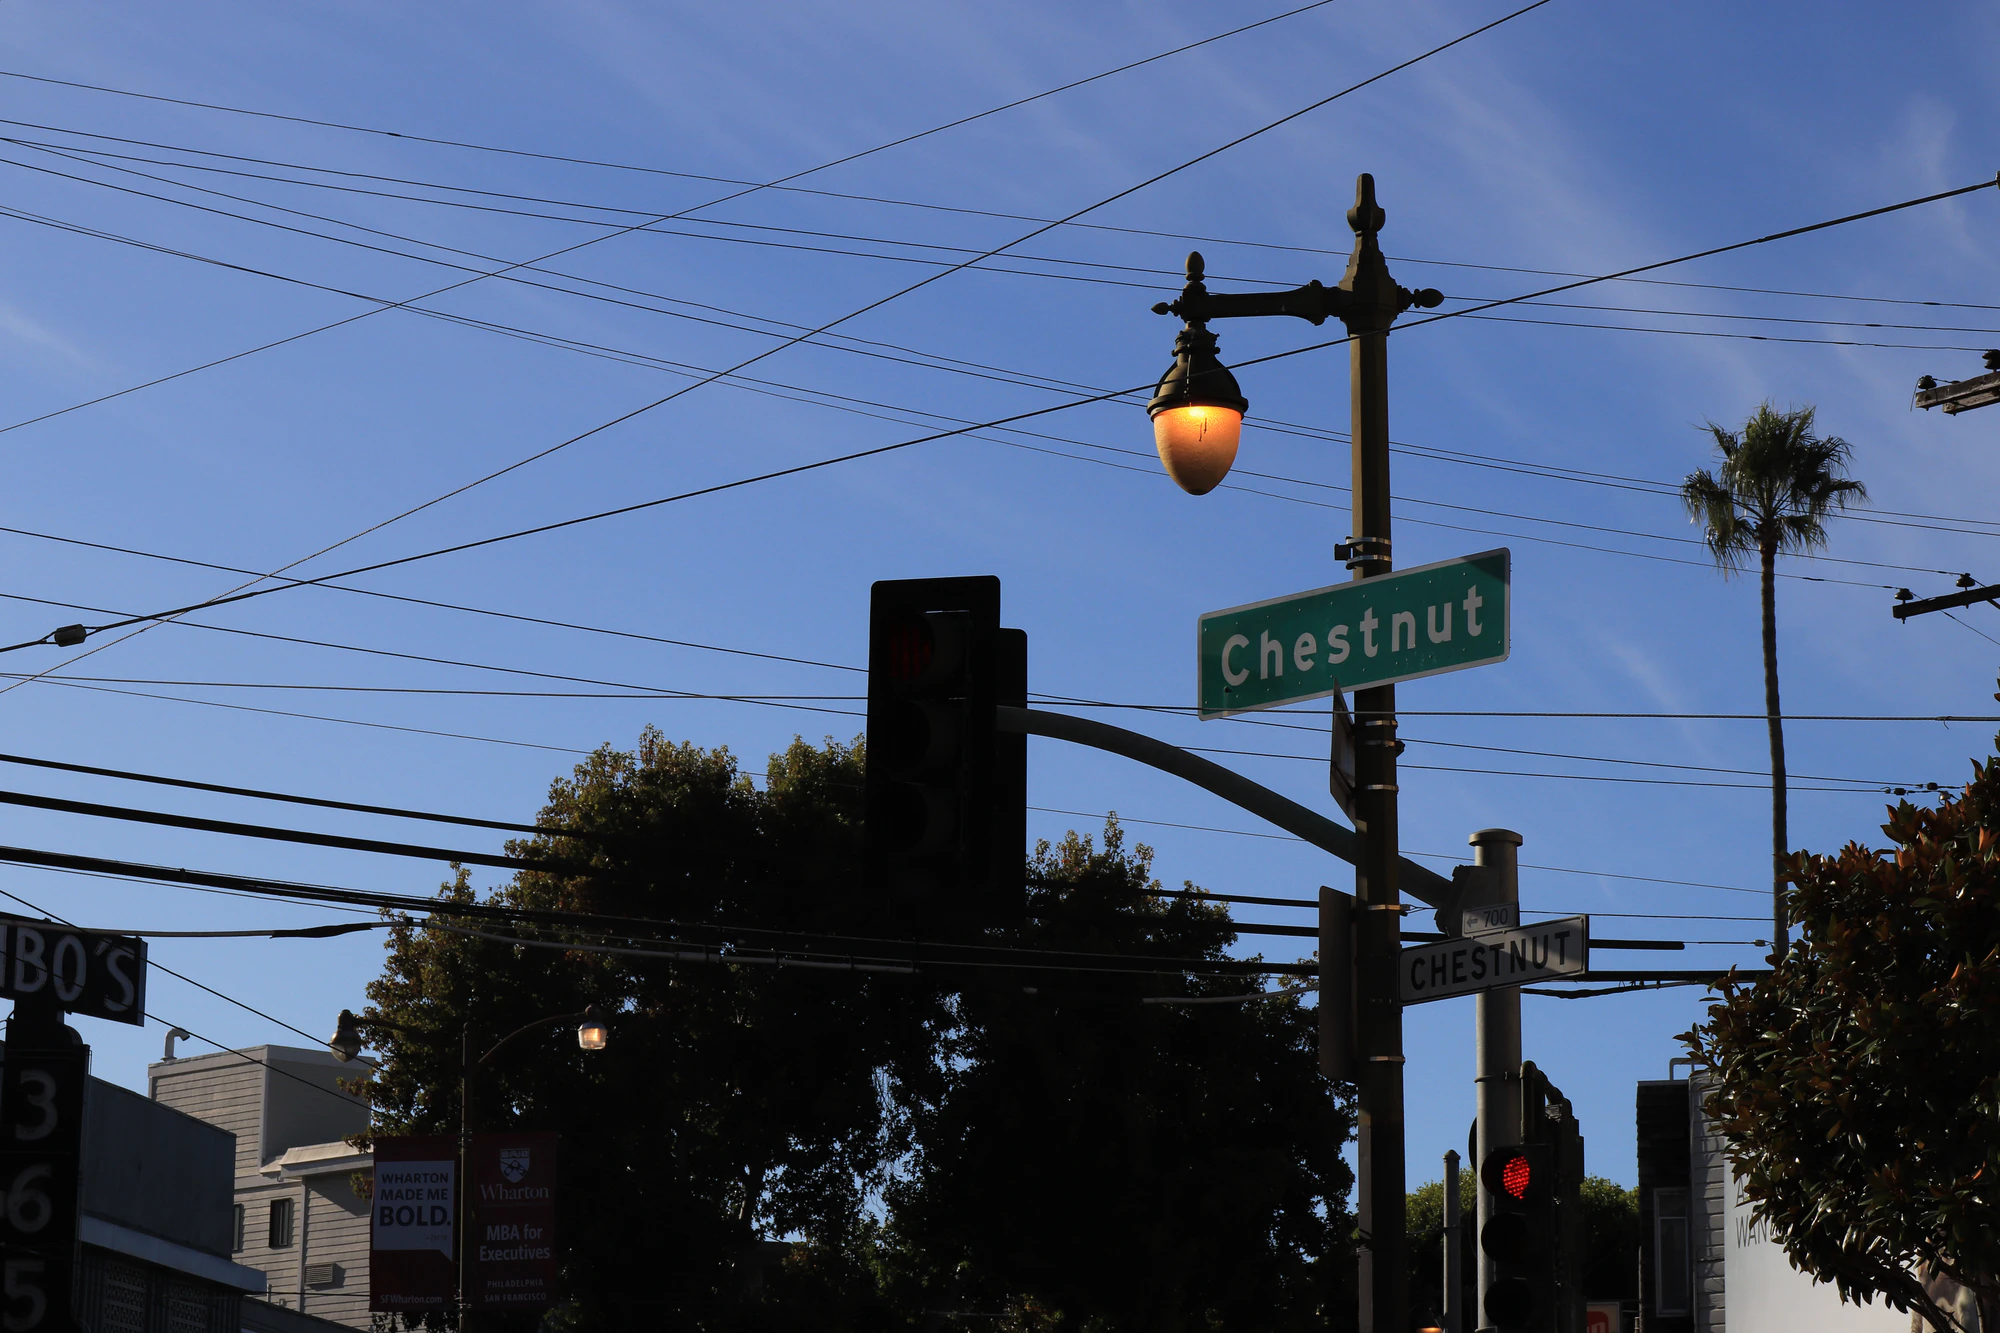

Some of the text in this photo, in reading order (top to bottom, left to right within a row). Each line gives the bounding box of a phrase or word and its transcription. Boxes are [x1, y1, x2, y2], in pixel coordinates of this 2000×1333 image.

[1221, 584, 1483, 687] Chestnut
[1483, 908, 1508, 928] 700
[0, 924, 136, 1012] BO'S
[1411, 930, 1570, 990] CHESTNUT
[381, 1172, 449, 1184] WHARTON
[380, 1188, 449, 1201] MADE ME
[480, 1183, 550, 1200] Wharton
[379, 1205, 452, 1227] BOLD.
[486, 1223, 543, 1241] MBA for
[479, 1243, 551, 1262] Executives
[487, 1278, 544, 1289] PHILADELPHIA
[380, 1294, 443, 1304] SFWharton.com
[484, 1292, 547, 1303] SAN FRANCISCO
